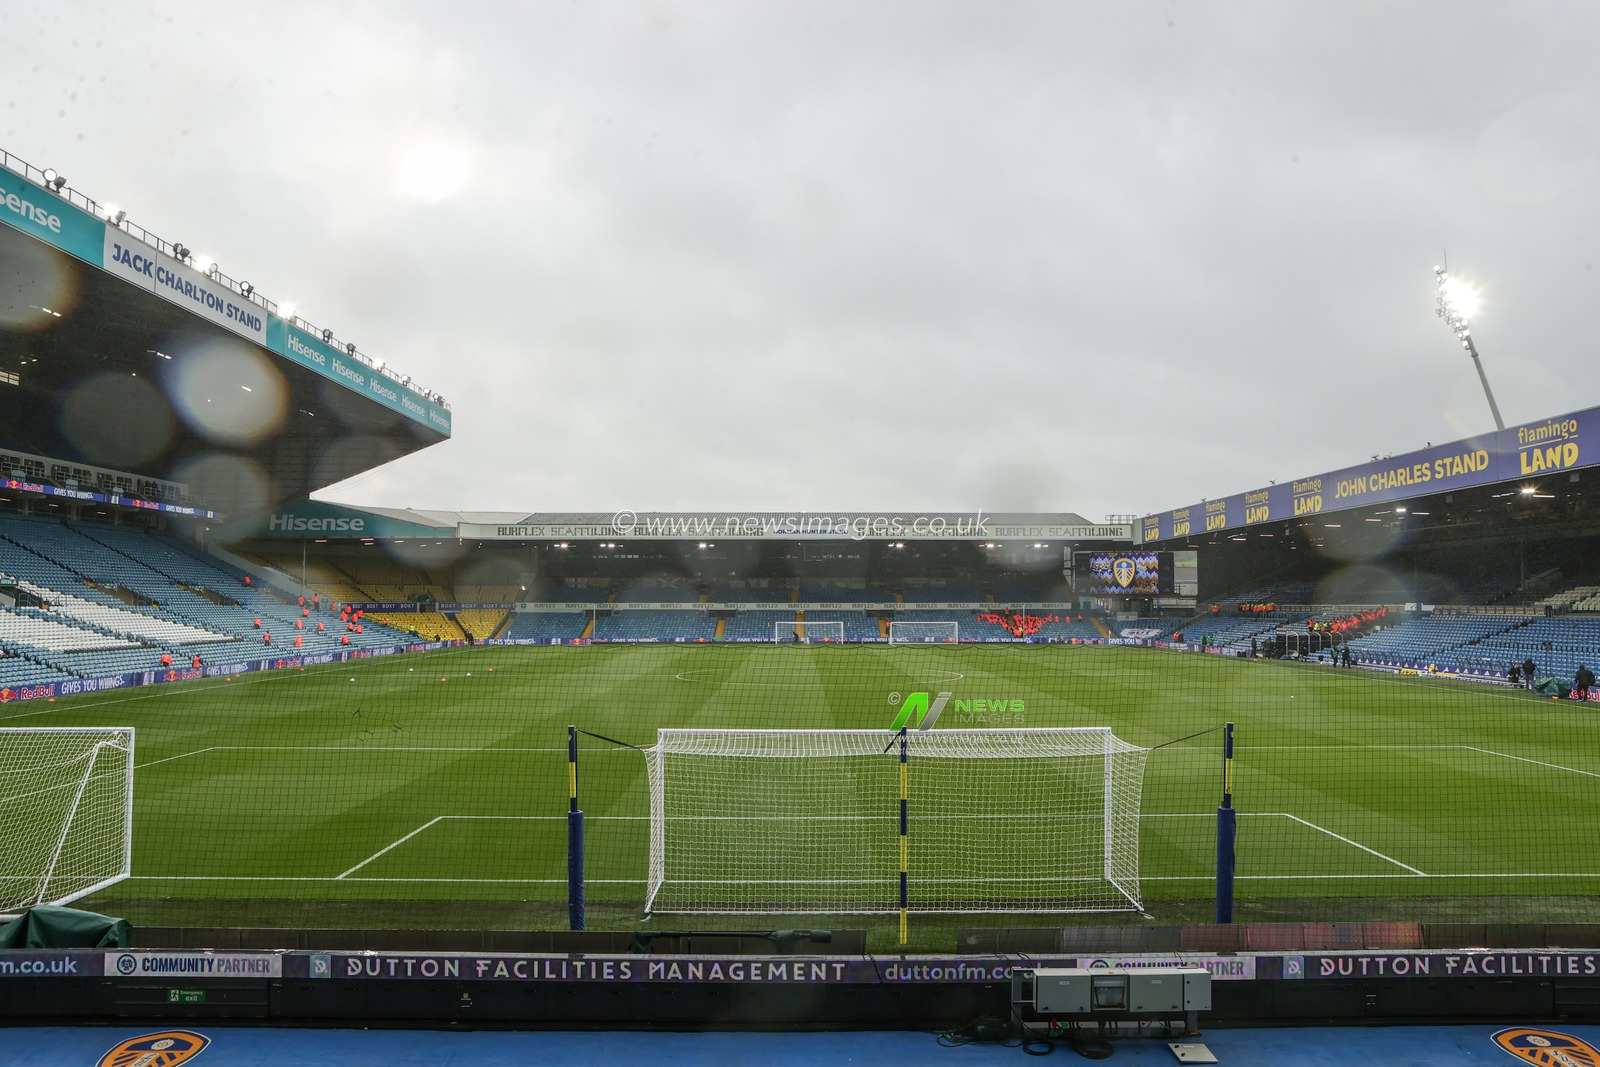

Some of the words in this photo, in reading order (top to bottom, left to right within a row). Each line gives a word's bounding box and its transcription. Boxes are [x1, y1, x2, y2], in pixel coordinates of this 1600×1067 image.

[112, 243, 153, 279] JACK
[156, 266, 223, 314] CHARLTON
[226, 302, 262, 332] STAND
[287, 334, 326, 366] Hisense
[332, 357, 365, 386] Hisense
[369, 377, 397, 402] Hisense
[402, 393, 425, 417] Hisense
[429, 408, 450, 430] Hisense
[1518, 419, 1577, 444] flamingo
[1520, 442, 1579, 475] LAND
[1335, 477, 1367, 499] JOHN
[1369, 462, 1430, 492] CHARLES
[1434, 450, 1489, 479] STAND
[54, 488, 66, 496] GIVES
[1293, 478, 1322, 493] flamingo
[1245, 490, 1269, 503] flamingo
[1173, 508, 1190, 519] flamingo
[1206, 500, 1226, 512] flamingo
[1294, 495, 1322, 516] LAND
[269, 514, 364, 531] Hisense
[1206, 514, 1226, 531] LAND
[1246, 505, 1269, 524] LAND
[497, 527, 545, 536] BURFLEX
[551, 527, 626, 536] SCAFFOLDING
[995, 528, 1043, 537] BURFLEX
[1049, 528, 1123, 537] SCAFFOLDING
[1145, 528, 1159, 542] LAND
[1173, 521, 1190, 537] LAND
[207, 666, 220, 676] GIVES
[220, 665, 231, 675] YOU
[61, 681, 81, 694] GIVES
[83, 679, 97, 691] YOU
[142, 957, 214, 973] COMMUNITY
[216, 957, 270, 973] PARTNER
[347, 958, 459, 977] DUTTON
[476, 960, 632, 979] FACILITIES
[649, 962, 845, 980] MANAGEMENT
[1320, 957, 1430, 976] DUTTON
[1446, 956, 1596, 975] FACILITIES
